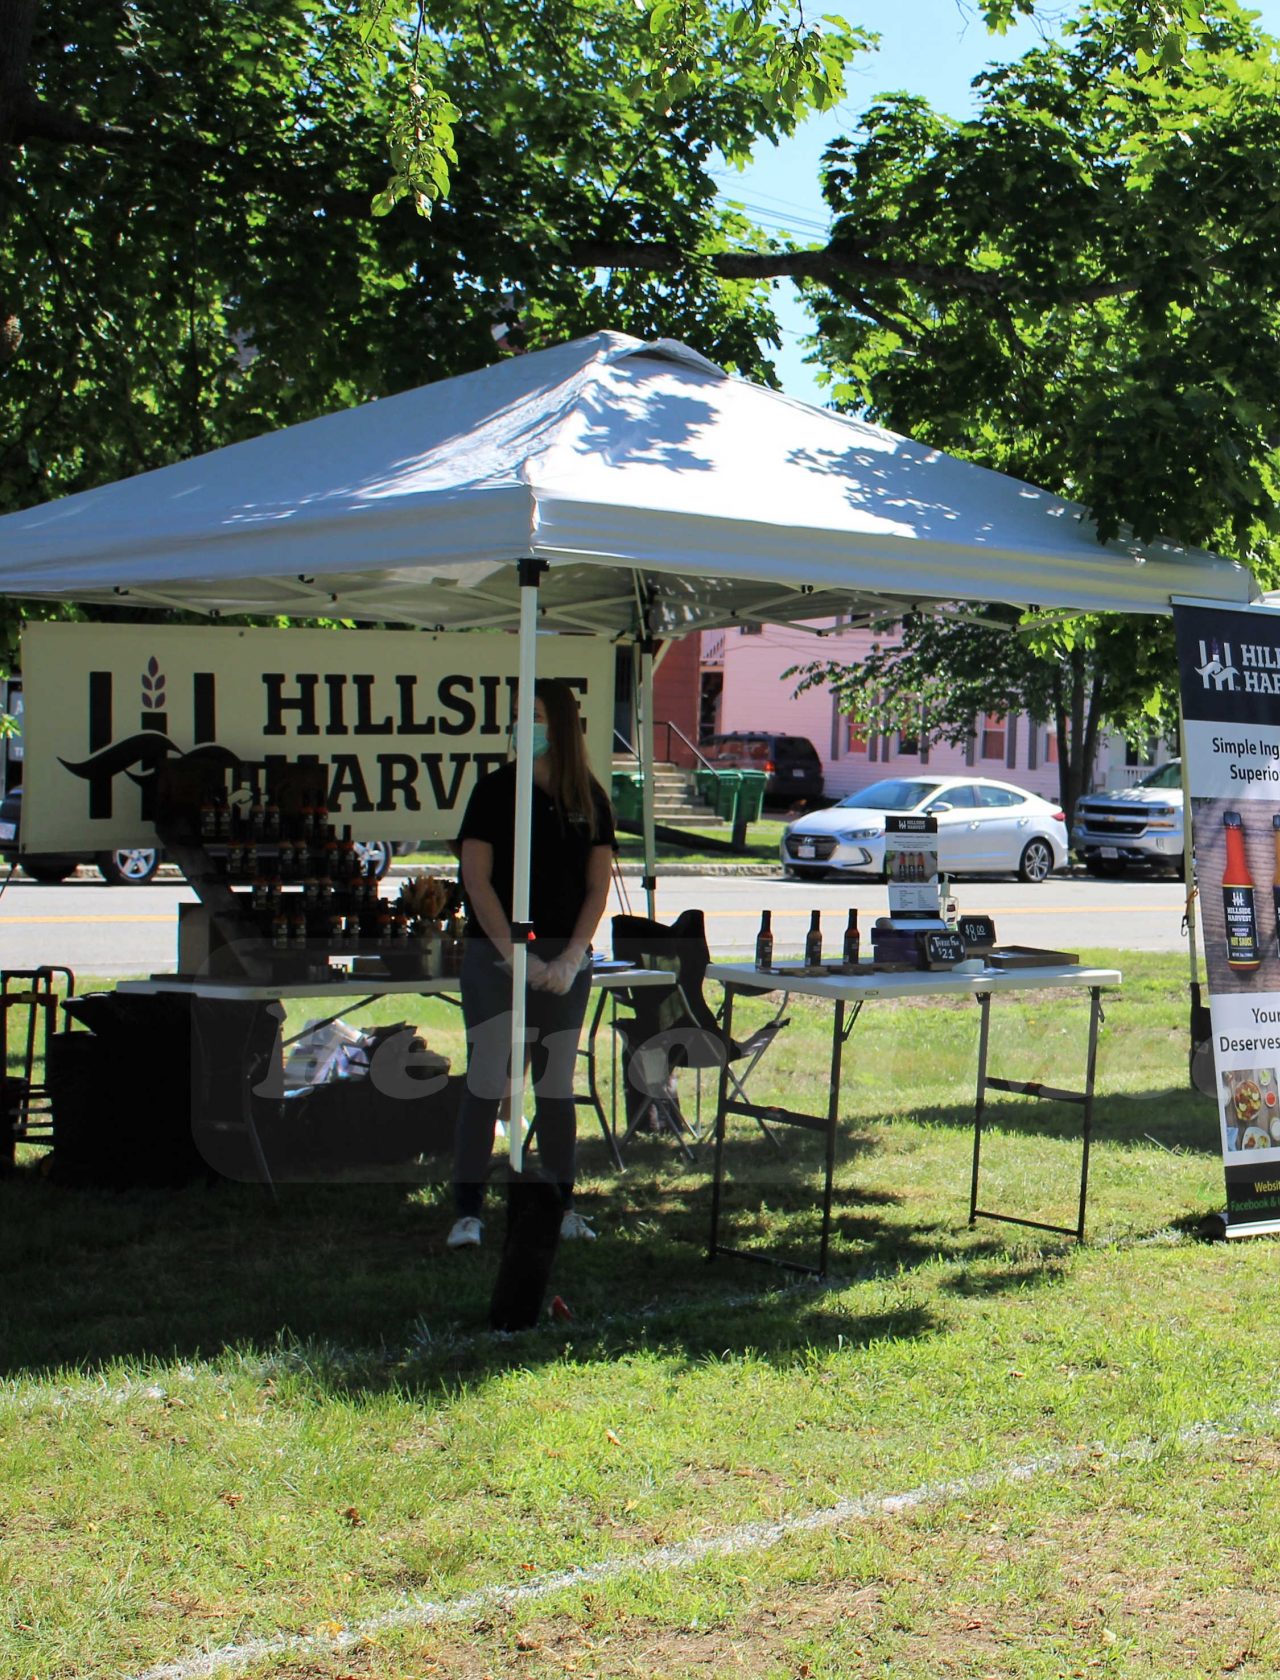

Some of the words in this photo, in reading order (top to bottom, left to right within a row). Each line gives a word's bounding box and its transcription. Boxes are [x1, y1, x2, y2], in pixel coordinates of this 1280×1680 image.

[263, 673, 588, 735] HILLSIE
[1212, 737, 1257, 758] Simple
[265, 753, 507, 812] HARV
[1239, 936, 1253, 946] SAUCE
[938, 947, 955, 959] $21
[1219, 1036, 1280, 1052] Deserves
[1231, 1198, 1269, 1212] Facebook
[1270, 1196, 1277, 1207] &
